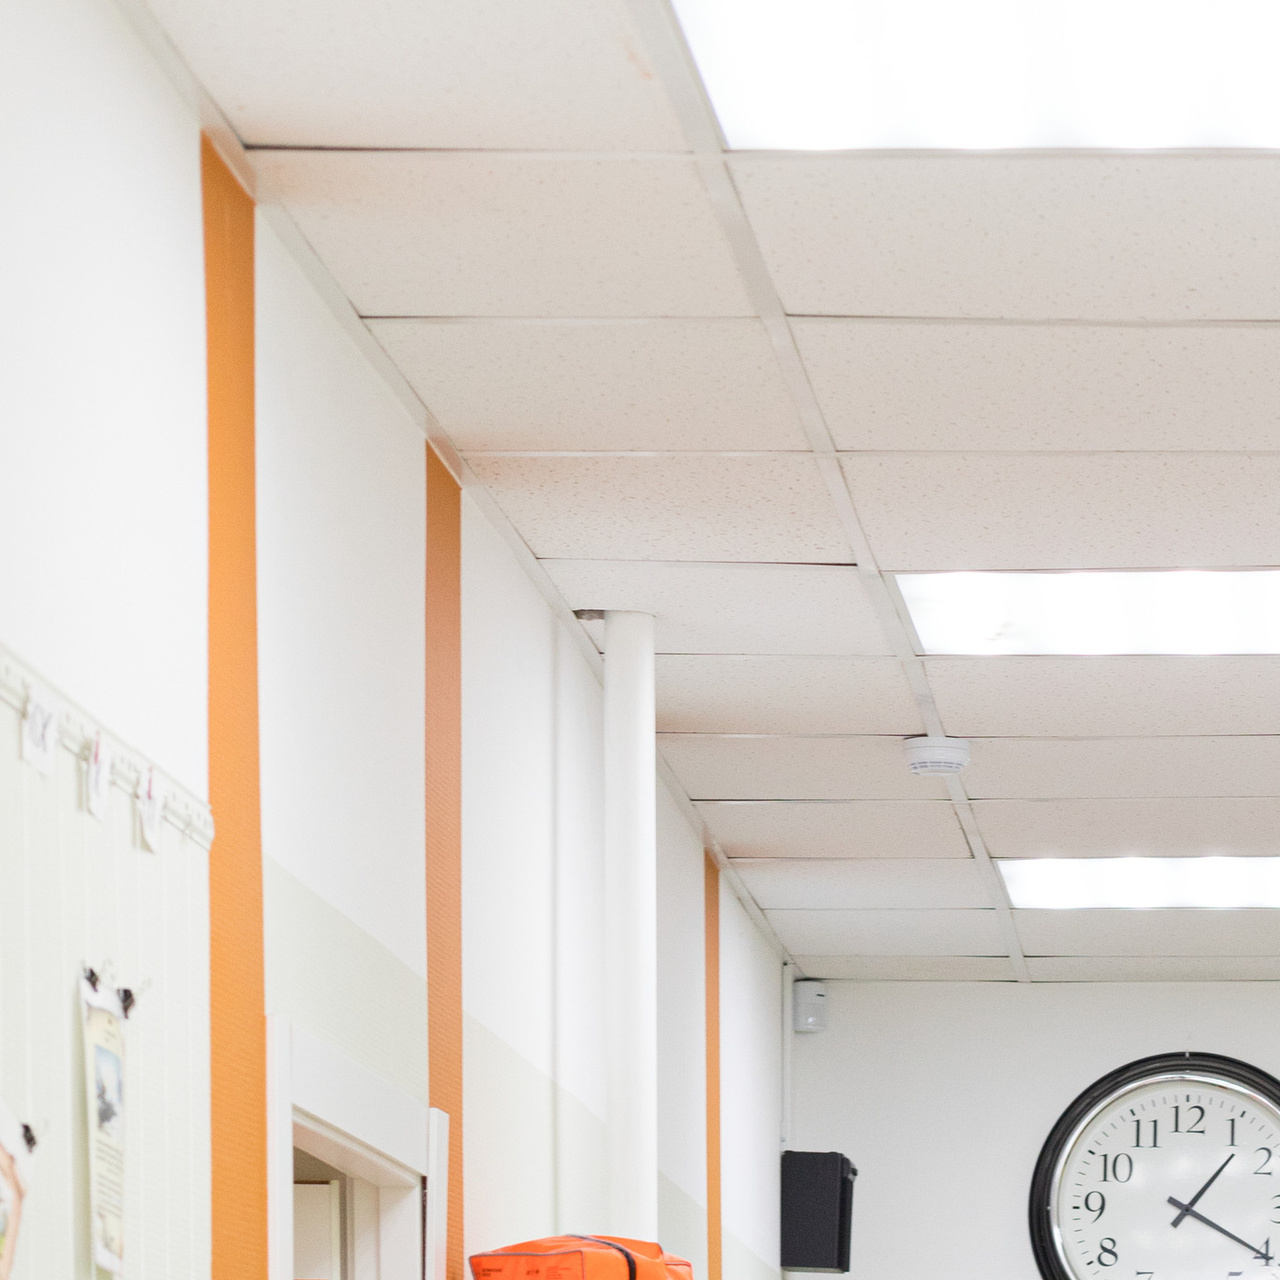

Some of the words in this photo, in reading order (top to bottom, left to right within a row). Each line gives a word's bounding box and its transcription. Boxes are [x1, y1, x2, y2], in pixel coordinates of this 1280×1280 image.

[1131, 1119, 1162, 1148] 11
[1170, 1105, 1205, 1134] 12
[1226, 1118, 1239, 1147] 1
[1099, 1153, 1133, 1183] 10
[1253, 1147, 1273, 1176] 2
[1084, 1191, 1106, 1224] 9
[1097, 1237, 1118, 1267] 8
[1253, 1237, 1274, 1266] 4
